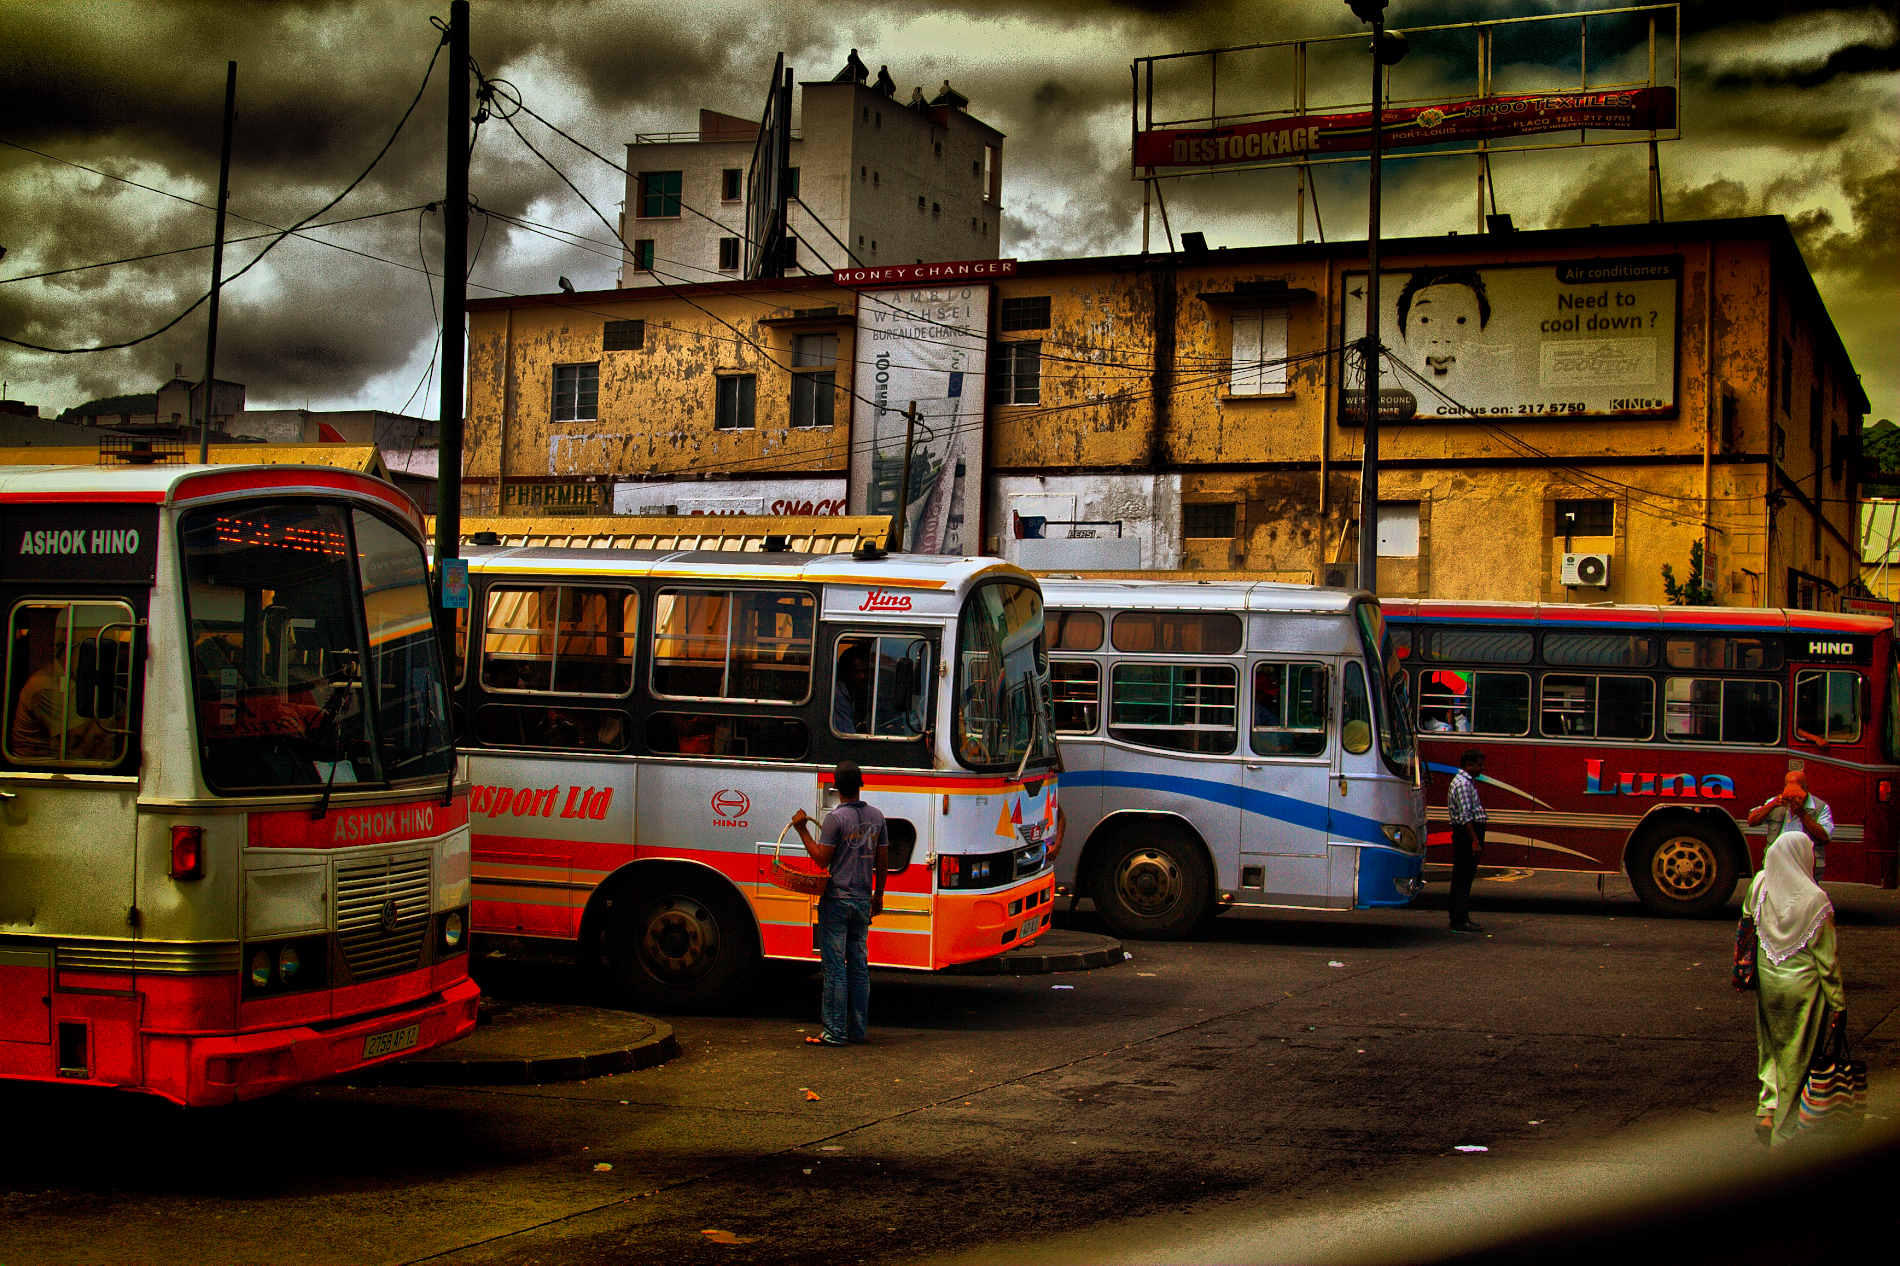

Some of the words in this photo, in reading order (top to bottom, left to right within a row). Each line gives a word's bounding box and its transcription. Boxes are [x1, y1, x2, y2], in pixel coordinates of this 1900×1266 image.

[1465, 101, 1528, 119] KINOO
[1535, 94, 1632, 111] TEXTILES
[1173, 126, 1320, 163] DESTOCKAGE
[838, 268, 906, 281] MONEY
[914, 262, 1012, 277] CHANGER
[1565, 266, 1584, 280] Air
[1587, 263, 1671, 279] conditioners
[1558, 291, 1608, 310] Need
[1616, 291, 1636, 306] to
[1540, 314, 1579, 332] cool
[1587, 313, 1642, 331] down
[1649, 311, 1658, 328] ?
[1470, 407, 1486, 415] us
[1491, 405, 1514, 414] on:
[1518, 404, 1544, 414] 217
[1549, 402, 1586, 413] 5750
[769, 498, 846, 516] SNACK
[20, 529, 87, 555] ASHOK
[91, 528, 140, 554] HINO
[859, 586, 912, 611] Hino
[1808, 641, 1854, 655] HINO
[1583, 758, 1737, 799] Luna
[560, 786, 615, 820] Ltd
[334, 810, 397, 841] ASHOK
[400, 806, 434, 833] HINO
[712, 820, 749, 828] HINO
